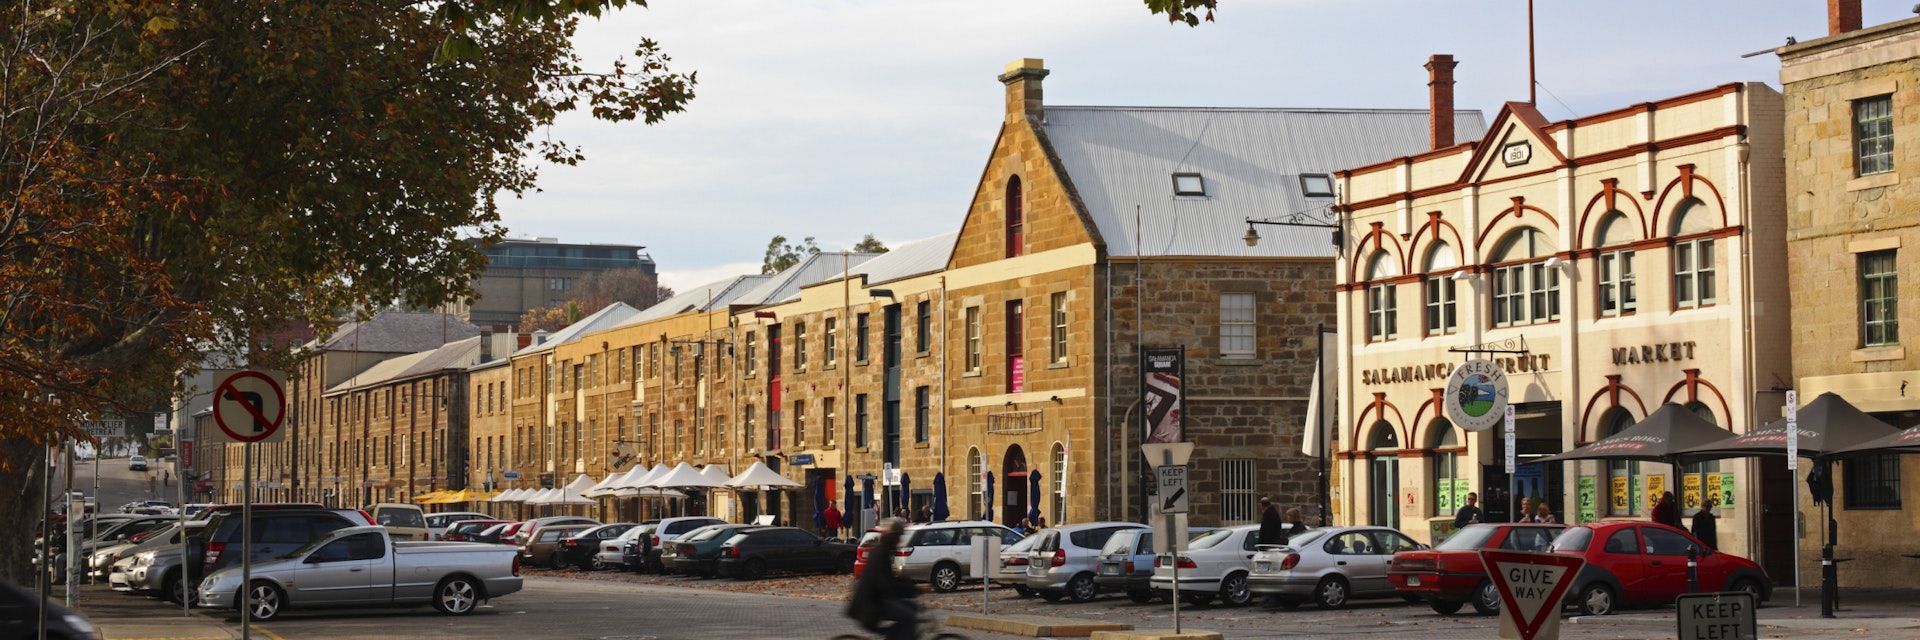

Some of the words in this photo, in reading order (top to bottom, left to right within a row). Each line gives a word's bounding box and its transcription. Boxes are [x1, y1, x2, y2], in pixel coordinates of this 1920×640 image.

[1510, 150, 1524, 160] 1901
[1362, 361, 1455, 386] SALAMANCA
[1494, 354, 1551, 374] FRUIT
[1611, 340, 1697, 366] MARKET
[1457, 362, 1501, 382] FRESH
[1162, 468, 1184, 477] KEEP
[1162, 478, 1183, 487] LEFT
[1509, 567, 1554, 585] GIVE
[1515, 585, 1546, 600] WAY
[1693, 602, 1742, 619] KEEP
[1696, 623, 1741, 640] LEFT
